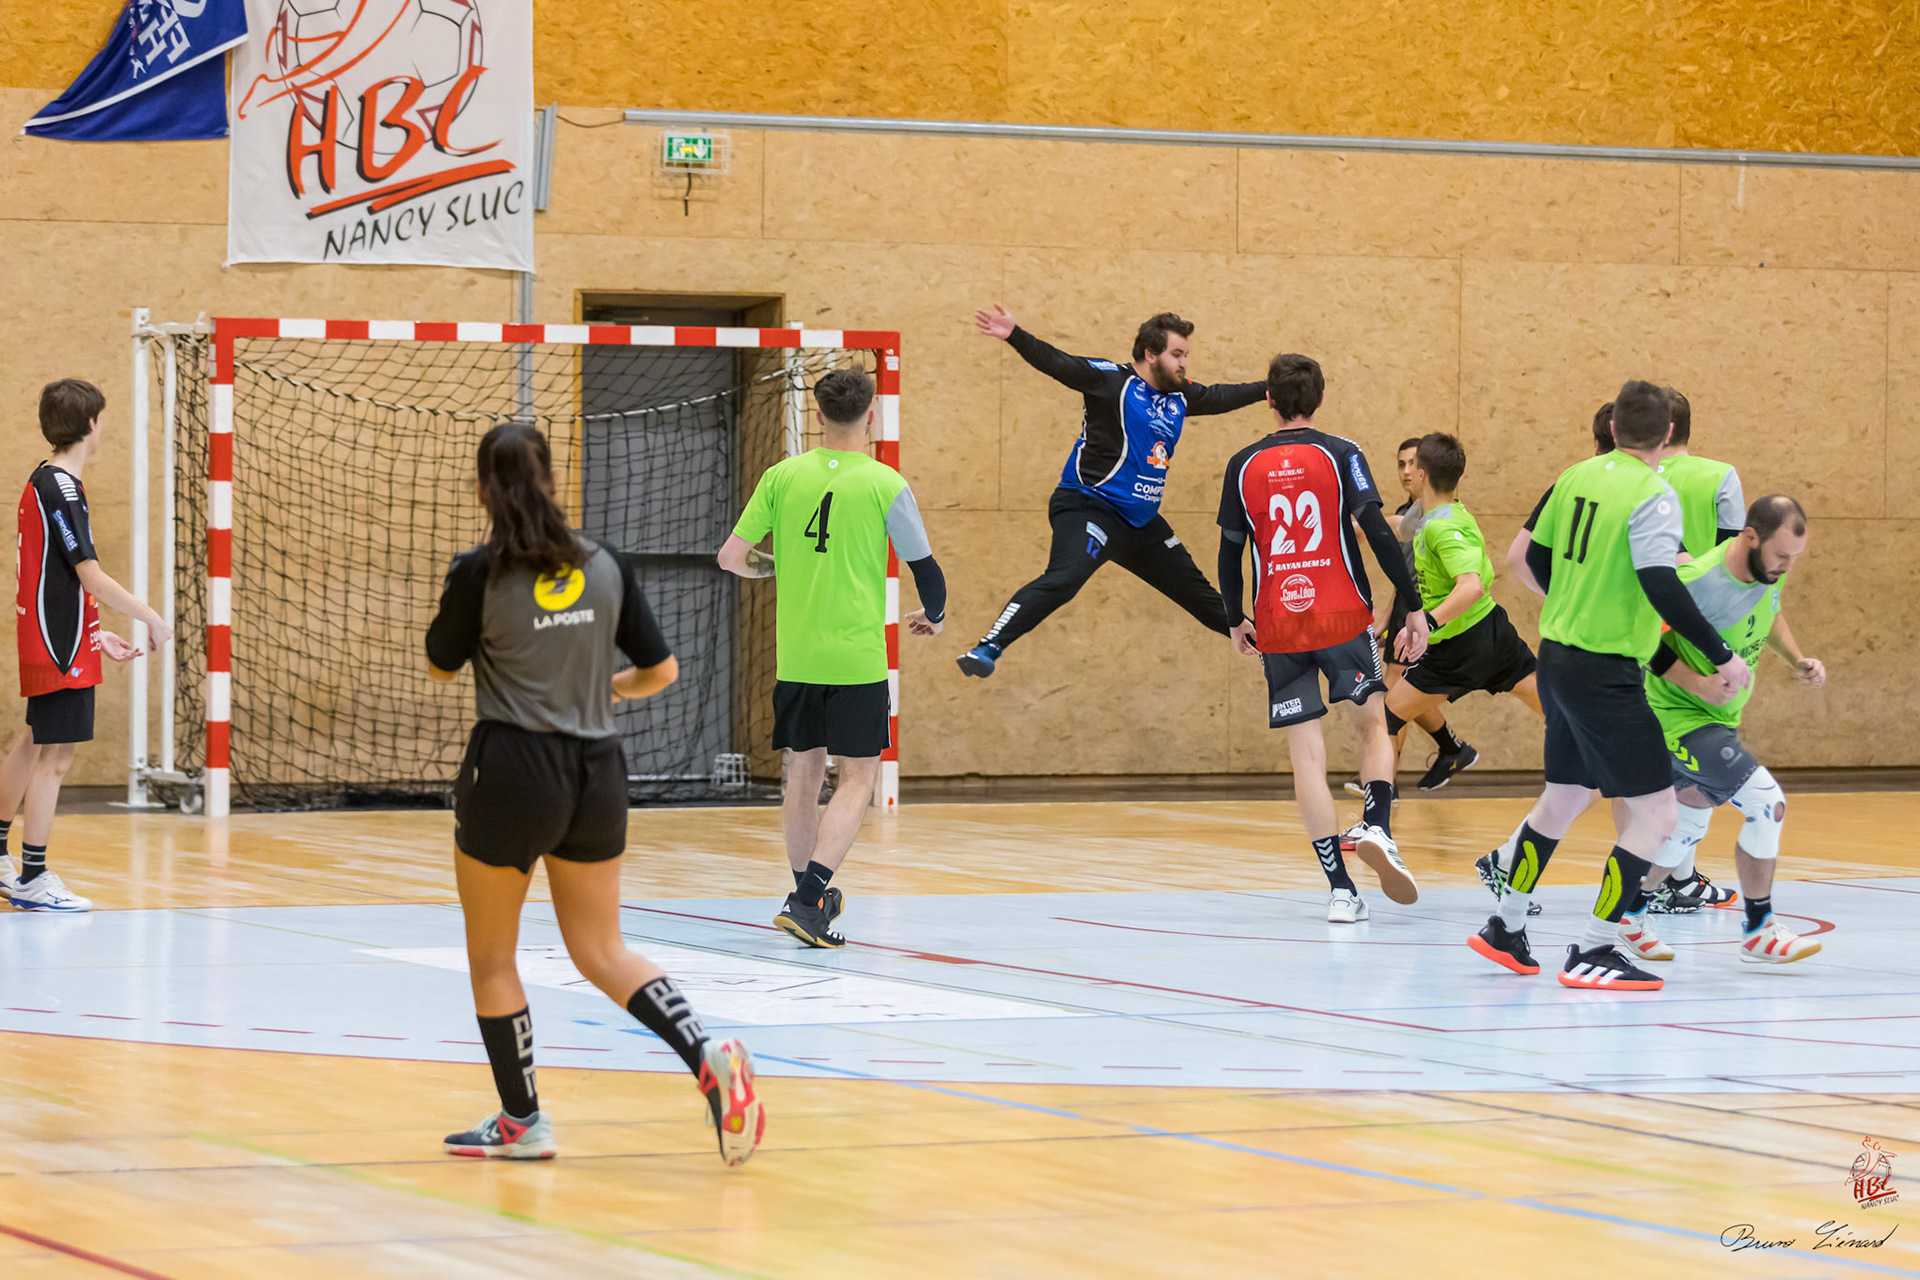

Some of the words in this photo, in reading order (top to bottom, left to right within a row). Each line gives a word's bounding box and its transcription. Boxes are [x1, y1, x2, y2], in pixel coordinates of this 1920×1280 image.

[286, 65, 504, 199] HBC
[323, 202, 436, 261] NANCY
[446, 180, 524, 231] SLUC
[1268, 470, 1278, 478] AU
[1278, 468, 1305, 477] BUREAU
[804, 491, 834, 553] 4
[1269, 490, 1323, 556] 29
[1563, 496, 1599, 564] 11
[1275, 561, 1301, 572] RAYAN
[1302, 559, 1319, 568] DEM
[1319, 558, 1331, 567] 54
[533, 615, 553, 630] LA
[553, 608, 595, 626] POSTE
[1279, 705, 1303, 717] SPORT
